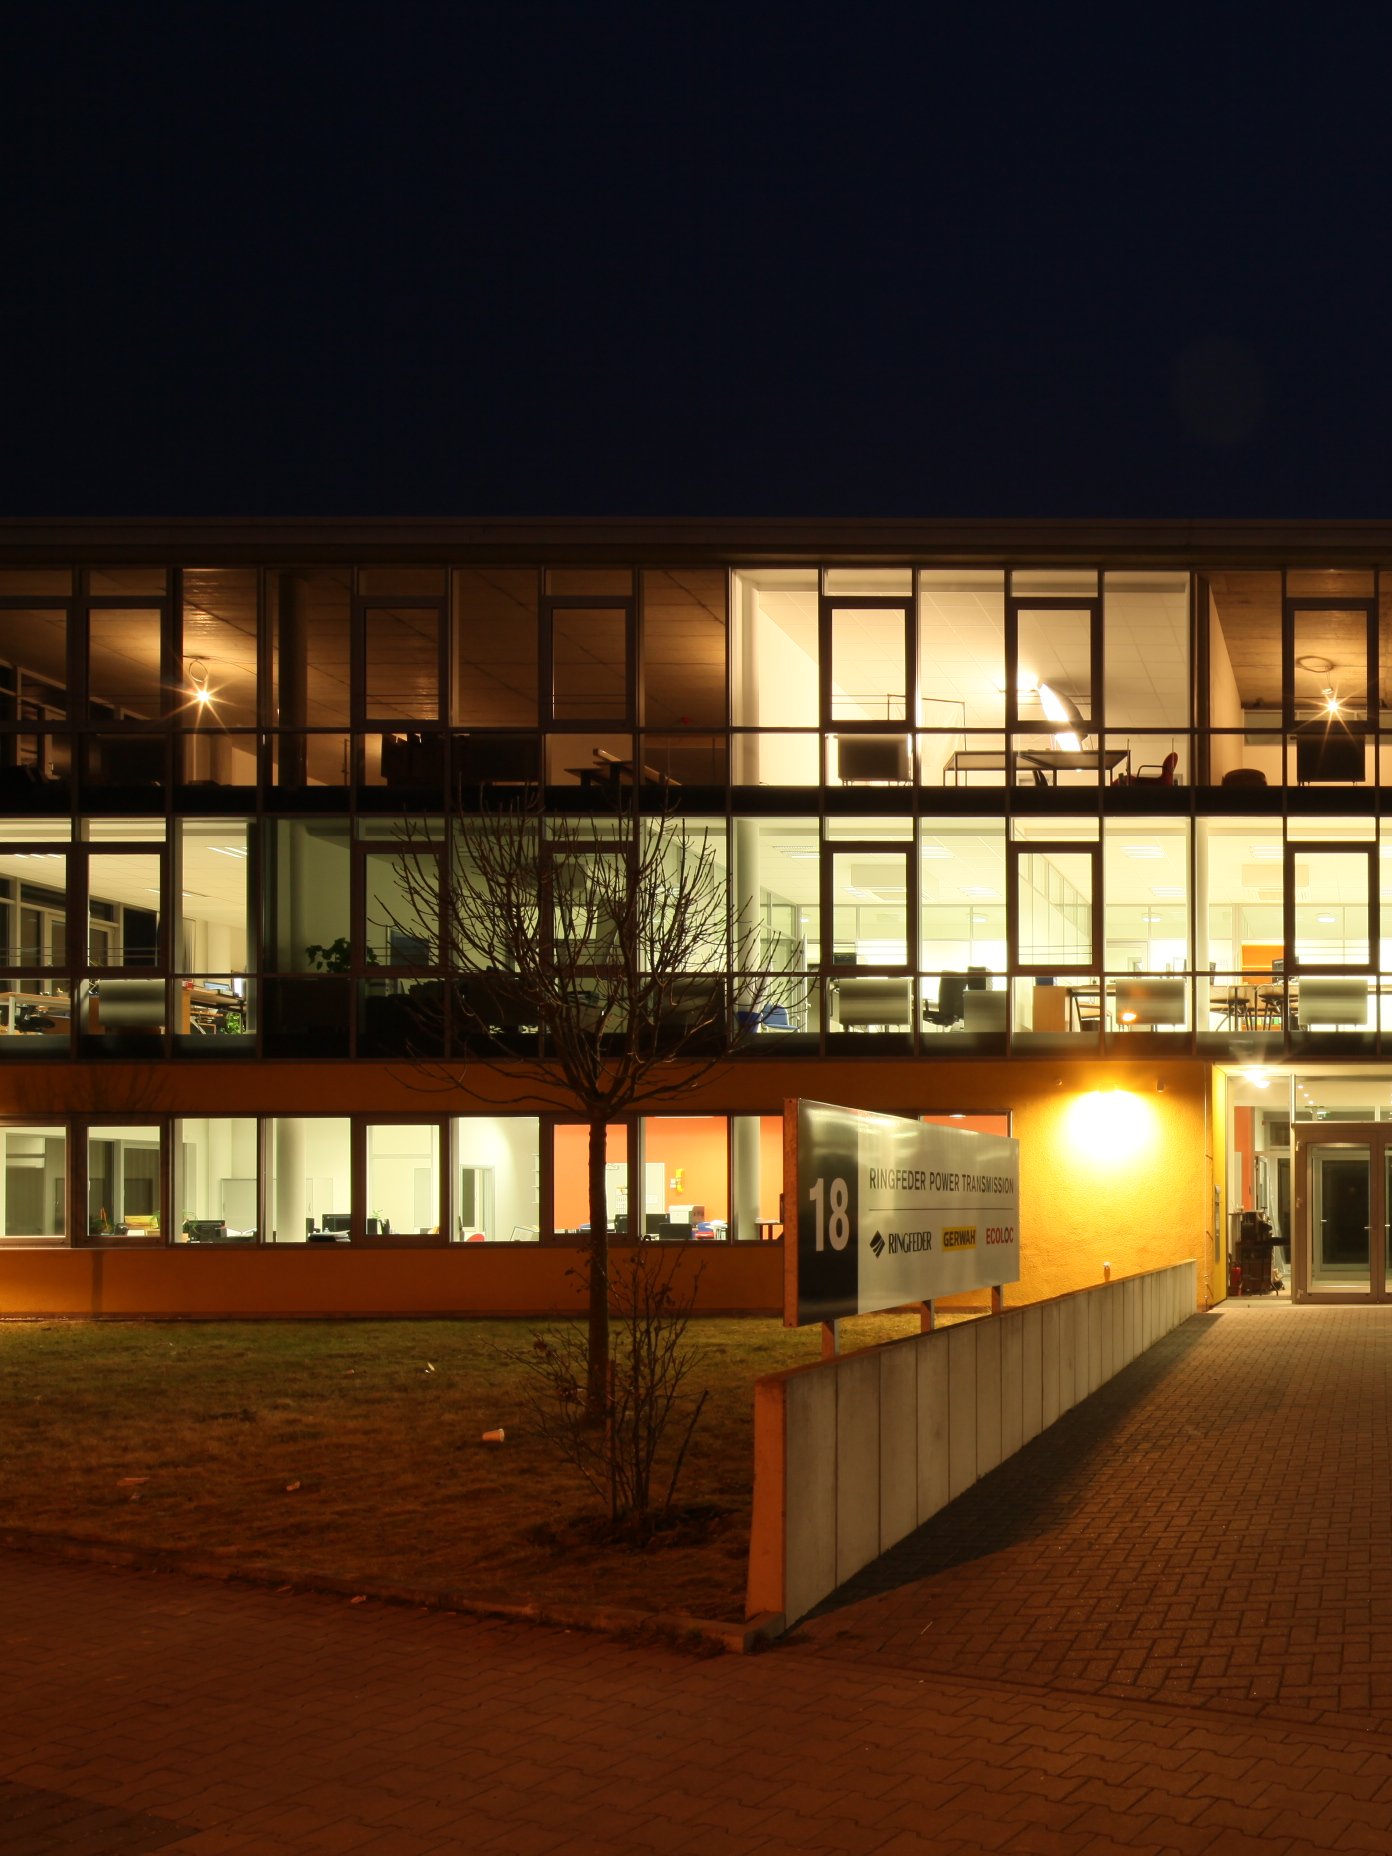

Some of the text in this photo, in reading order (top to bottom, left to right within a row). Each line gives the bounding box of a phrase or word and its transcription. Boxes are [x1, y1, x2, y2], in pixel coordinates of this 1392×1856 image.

[869, 1168, 1014, 1194] RINGFEDER POWER TRANSMISSION
[809, 1177, 850, 1252] 18
[888, 1231, 932, 1254] RINGFEDER
[943, 1229, 976, 1247] GERWAH
[986, 1227, 1014, 1244] ECOLOC
